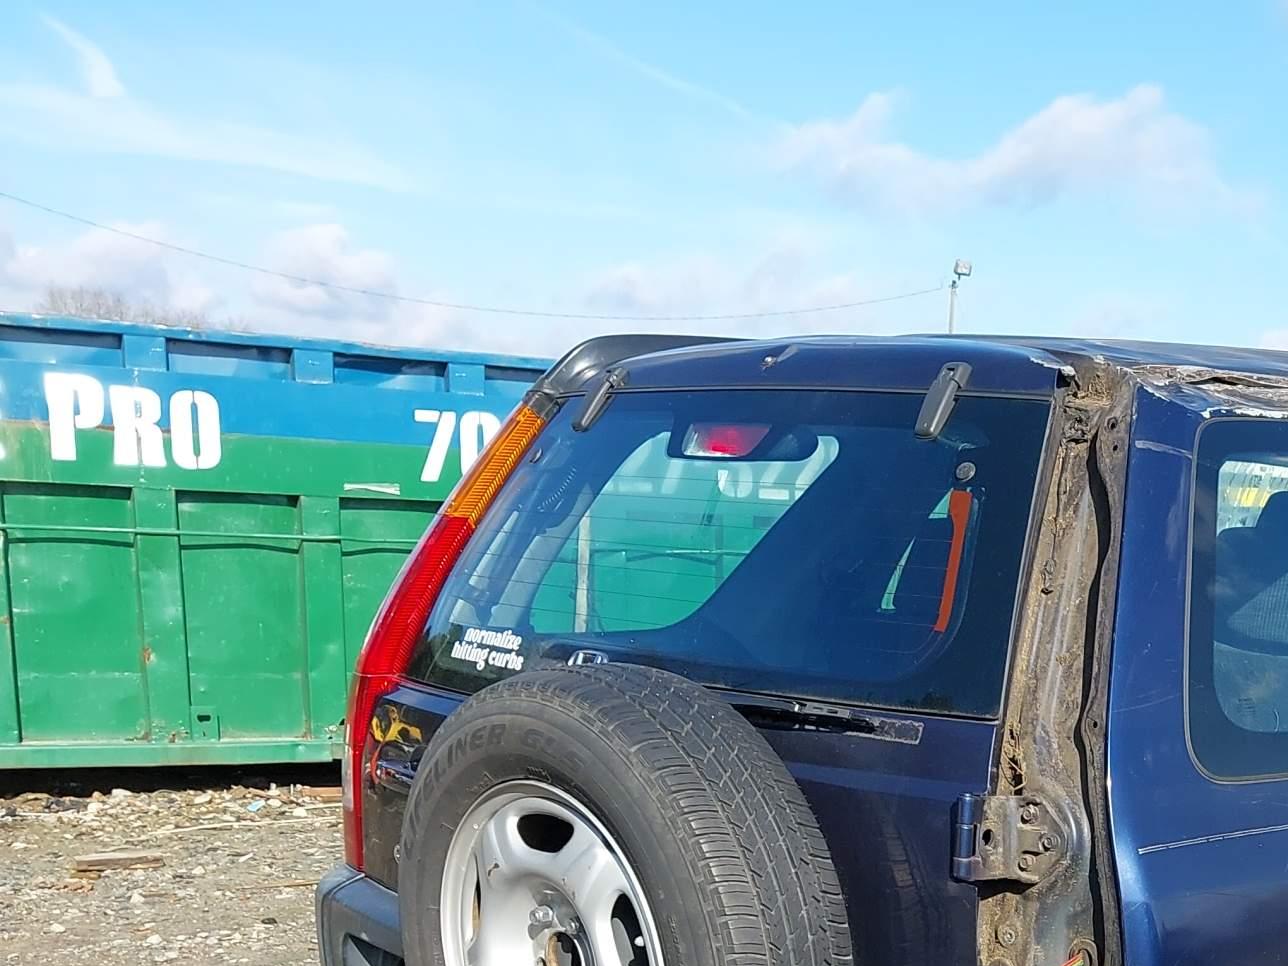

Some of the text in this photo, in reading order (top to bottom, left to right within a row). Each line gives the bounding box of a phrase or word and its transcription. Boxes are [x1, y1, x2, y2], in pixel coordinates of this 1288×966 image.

[43, 371, 222, 470] PRO
[464, 627, 522, 651] normalize
[451, 640, 524, 671] hitting curbs
